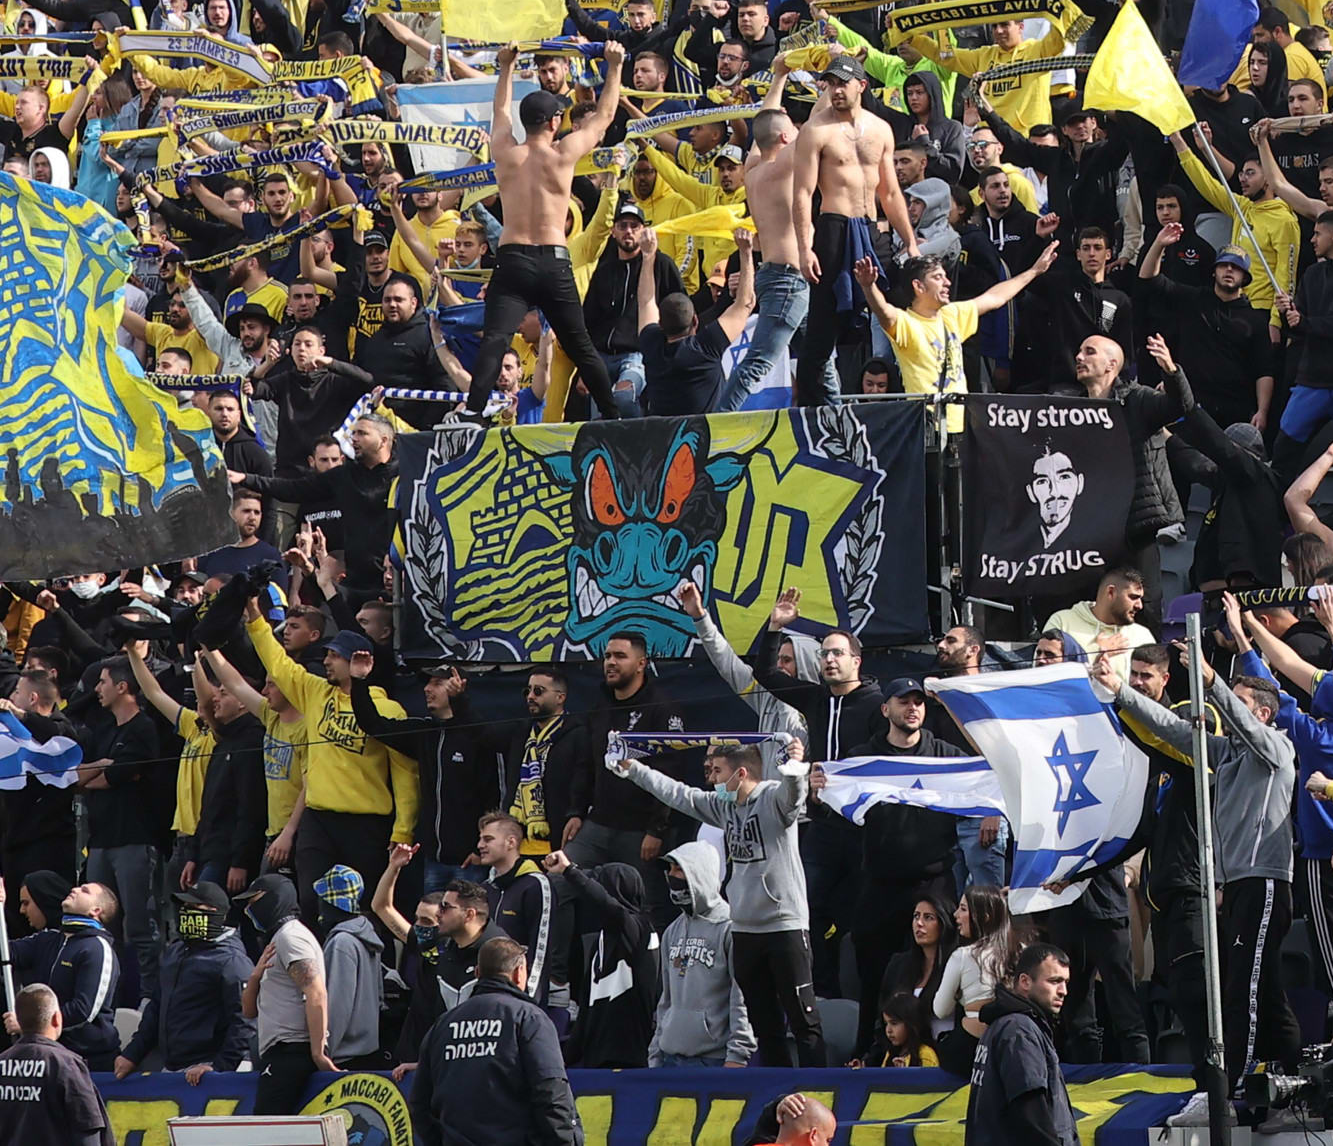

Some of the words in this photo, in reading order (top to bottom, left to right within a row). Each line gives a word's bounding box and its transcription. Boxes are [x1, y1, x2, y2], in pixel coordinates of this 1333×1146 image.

[900, 7, 969, 30] MACCABI
[971, 3, 999, 20] TEL
[1003, 0, 1040, 15] AVIV
[1046, 0, 1062, 15] FC
[394, 123, 484, 156] MACCABI
[202, 374, 236, 386] CLUB
[987, 403, 1032, 433] Stay
[1036, 404, 1114, 430] strong
[979, 553, 1025, 584] Stay
[1024, 549, 1106, 577] STRUG
[449, 1018, 503, 1040] מטאור
[444, 1040, 498, 1061] אבטחה
[340, 1081, 393, 1107] MACCABI
